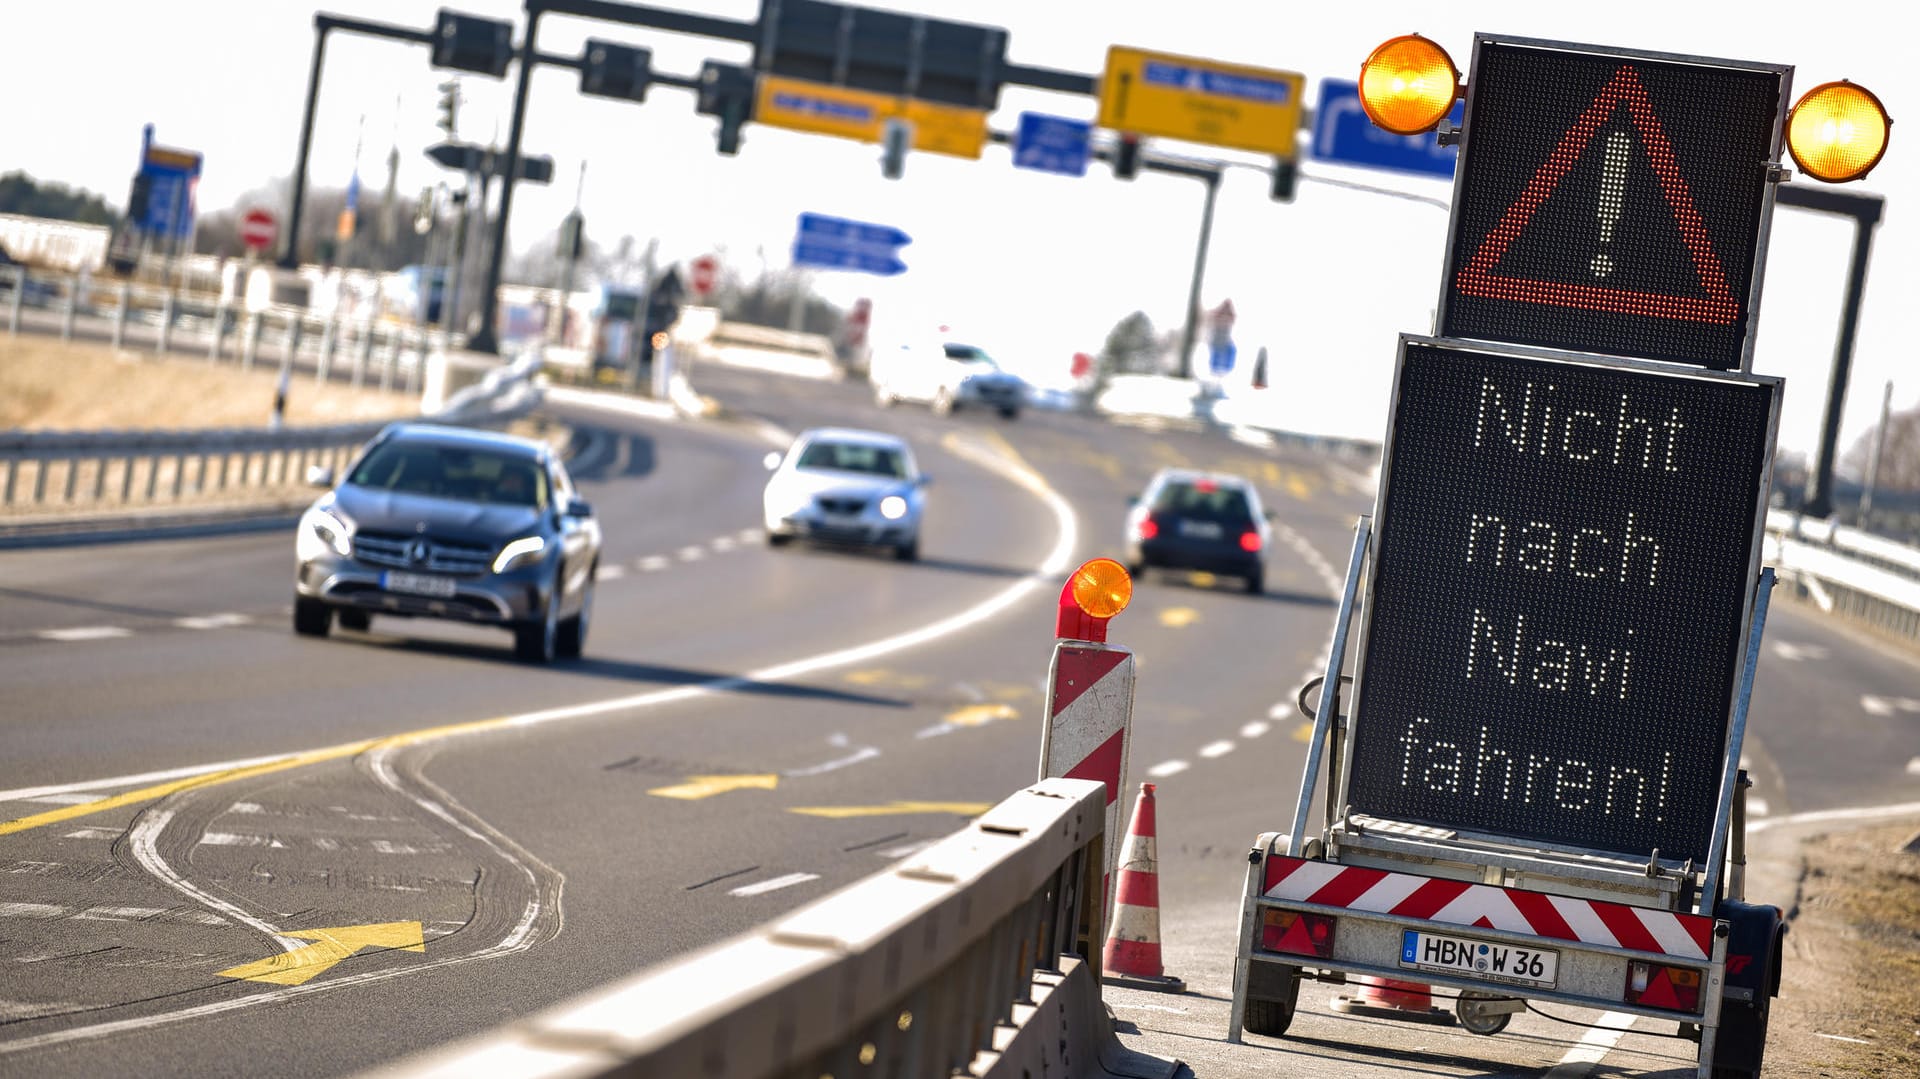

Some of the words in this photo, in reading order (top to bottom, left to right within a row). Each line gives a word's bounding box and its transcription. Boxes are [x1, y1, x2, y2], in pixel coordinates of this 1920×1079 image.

[1474, 376, 1684, 473] Nicht
[1466, 511, 1661, 586] nach
[1466, 608, 1635, 699] Navi
[1399, 717, 1672, 822] fahren!
[1424, 938, 1475, 968] HBN
[1493, 947, 1508, 972] W
[1513, 951, 1544, 977] 36
